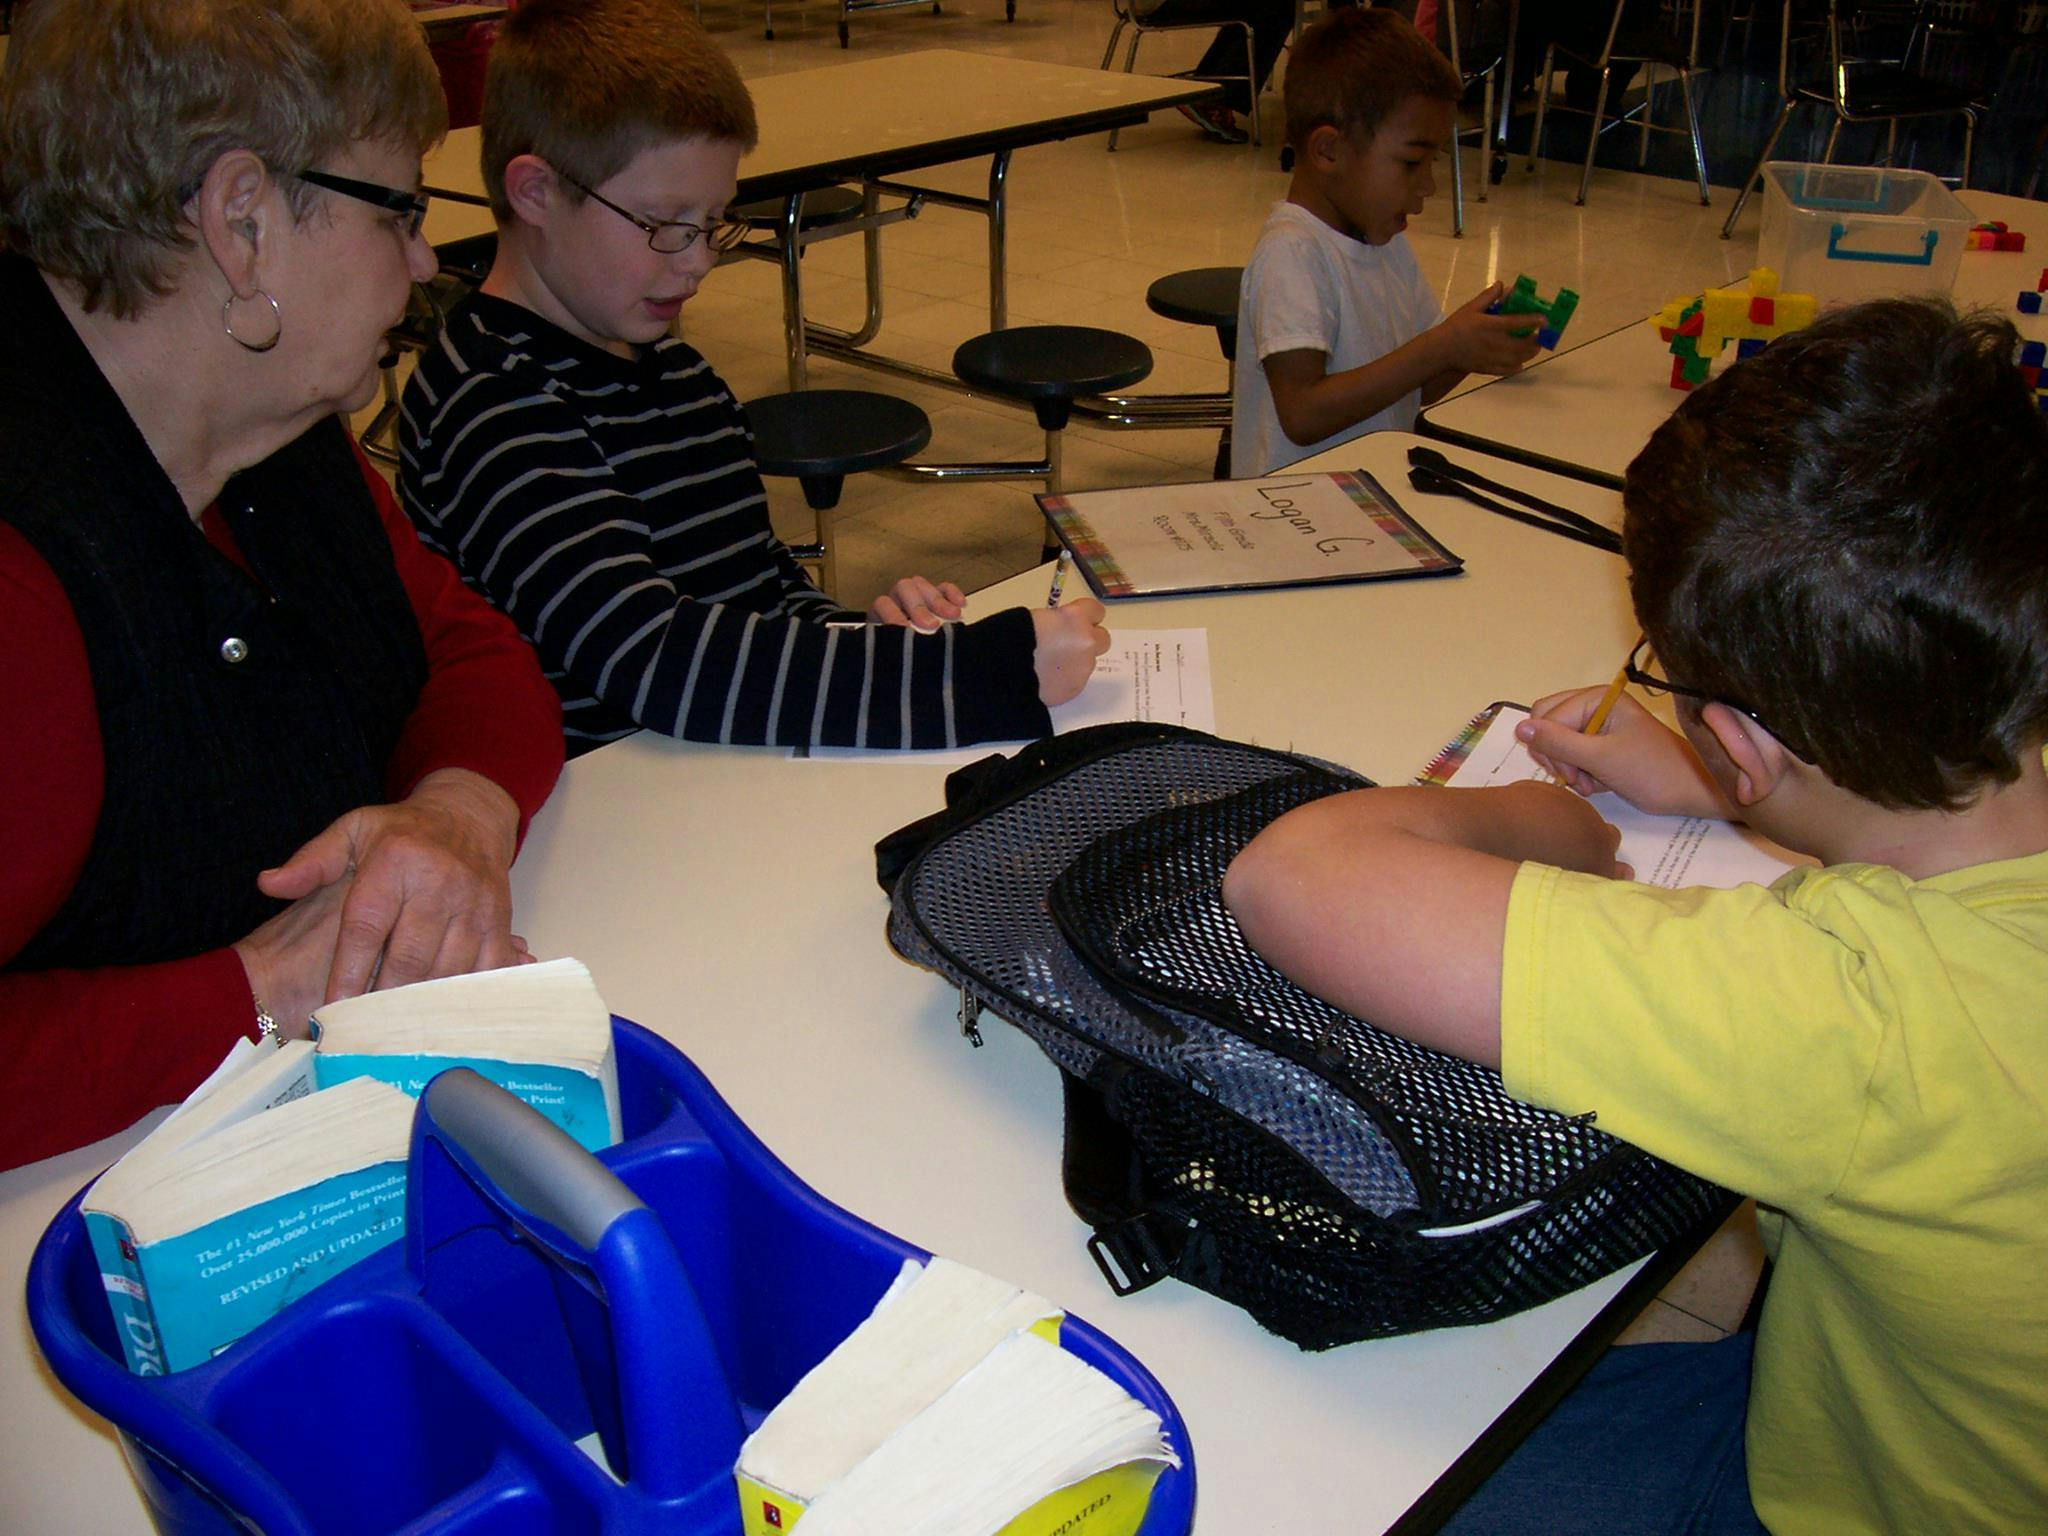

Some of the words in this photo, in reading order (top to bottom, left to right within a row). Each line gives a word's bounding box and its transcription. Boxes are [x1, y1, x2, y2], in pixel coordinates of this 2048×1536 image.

[1250, 482, 1316, 535] Logan
[1316, 537, 1374, 557] G.
[507, 1081, 564, 1091] Bestseller
[196, 1246, 222, 1265] The
[228, 1238, 241, 1252] #1
[246, 1226, 273, 1242] New
[278, 1210, 306, 1228] York
[310, 1198, 346, 1216] Times
[350, 1175, 407, 1200] Bestseller
[201, 1259, 233, 1279] Over
[311, 1210, 354, 1231] Copies
[357, 1202, 370, 1213] in
[220, 1266, 288, 1304] REVISED
[292, 1243, 325, 1272] AND
[329, 1216, 402, 1254] UPDATED
[1049, 1494, 1112, 1536] PDATED
